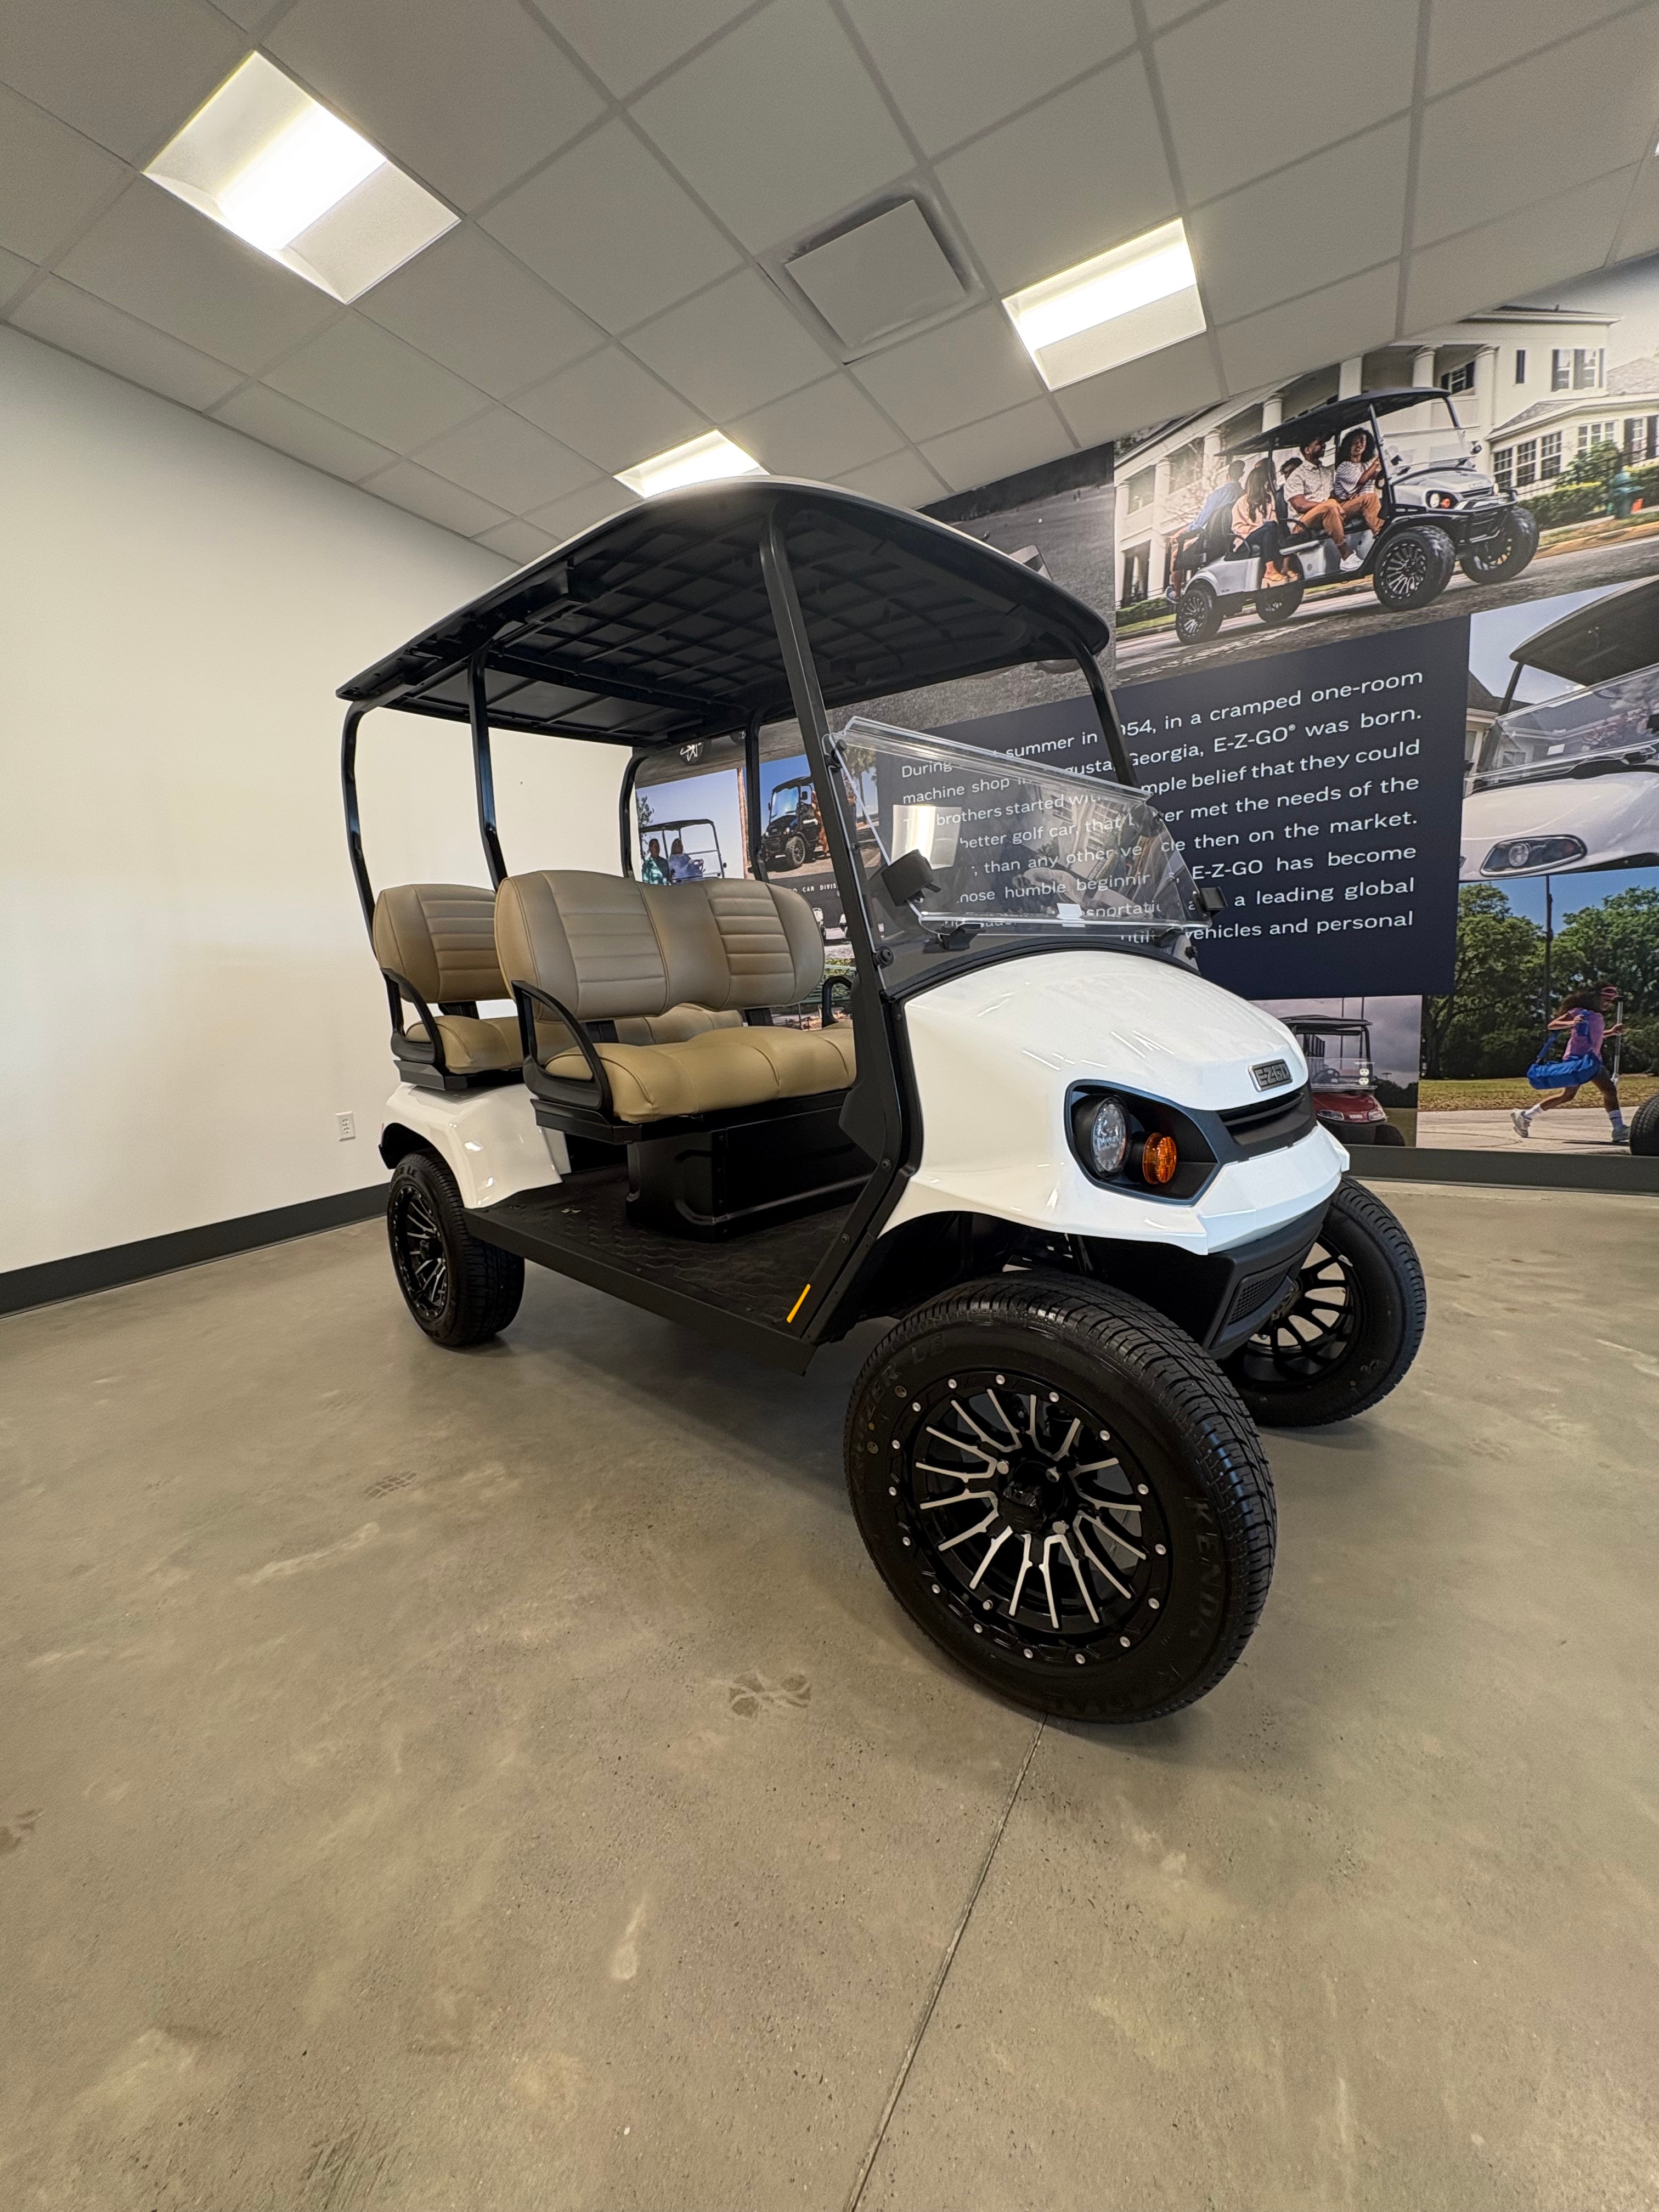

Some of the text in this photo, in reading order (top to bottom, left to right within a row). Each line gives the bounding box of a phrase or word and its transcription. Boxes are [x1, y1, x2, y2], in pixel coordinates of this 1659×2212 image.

[901, 761, 952, 778] During
[1006, 736, 1075, 758] summer
[1081, 731, 1098, 746] in
[1120, 719, 1156, 736] 54,
[1165, 715, 1182, 730] in
[1190, 714, 1202, 725] a
[1210, 690, 1301, 721] cramped
[1311, 672, 1423, 702] one-room
[903, 785, 965, 804] machine
[972, 778, 1010, 793] shop
[1305, 720, 1349, 737] was
[1361, 709, 1421, 729] born.
[936, 807, 1002, 826] brothers
[1006, 794, 1064, 815] started
[1141, 776, 1187, 795] mple
[1192, 766, 1247, 788] belief
[1251, 760, 1295, 778] that
[1300, 754, 1350, 771] they
[1356, 738, 1420, 763] could
[1012, 826, 1044, 845] golf
[1048, 825, 1079, 838] car,
[1085, 818, 1121, 832] that
[1191, 802, 1228, 819] met
[1235, 797, 1269, 812] the
[1277, 786, 1341, 807] needs
[1349, 781, 1372, 798] of
[1380, 777, 1419, 793] the
[984, 860, 1020, 874] than
[1028, 855, 1059, 869] any
[1066, 848, 1114, 864] other
[1194, 834, 1239, 849] then
[1249, 830, 1274, 843] on
[1284, 823, 1319, 838] the
[1330, 811, 1417, 833] market.
[820, 883, 837, 891] DIVIS
[957, 890, 996, 904] hose
[1005, 881, 1066, 900] humble
[1192, 860, 1263, 880] E-Z-GO
[1277, 857, 1313, 871] has
[1328, 848, 1416, 866] become
[1234, 896, 1245, 906] a
[1257, 887, 1334, 905] leading
[1345, 877, 1414, 900] global
[1185, 923, 1262, 940] vehicles
[1269, 918, 1307, 935] and
[1317, 911, 1413, 934] personal
